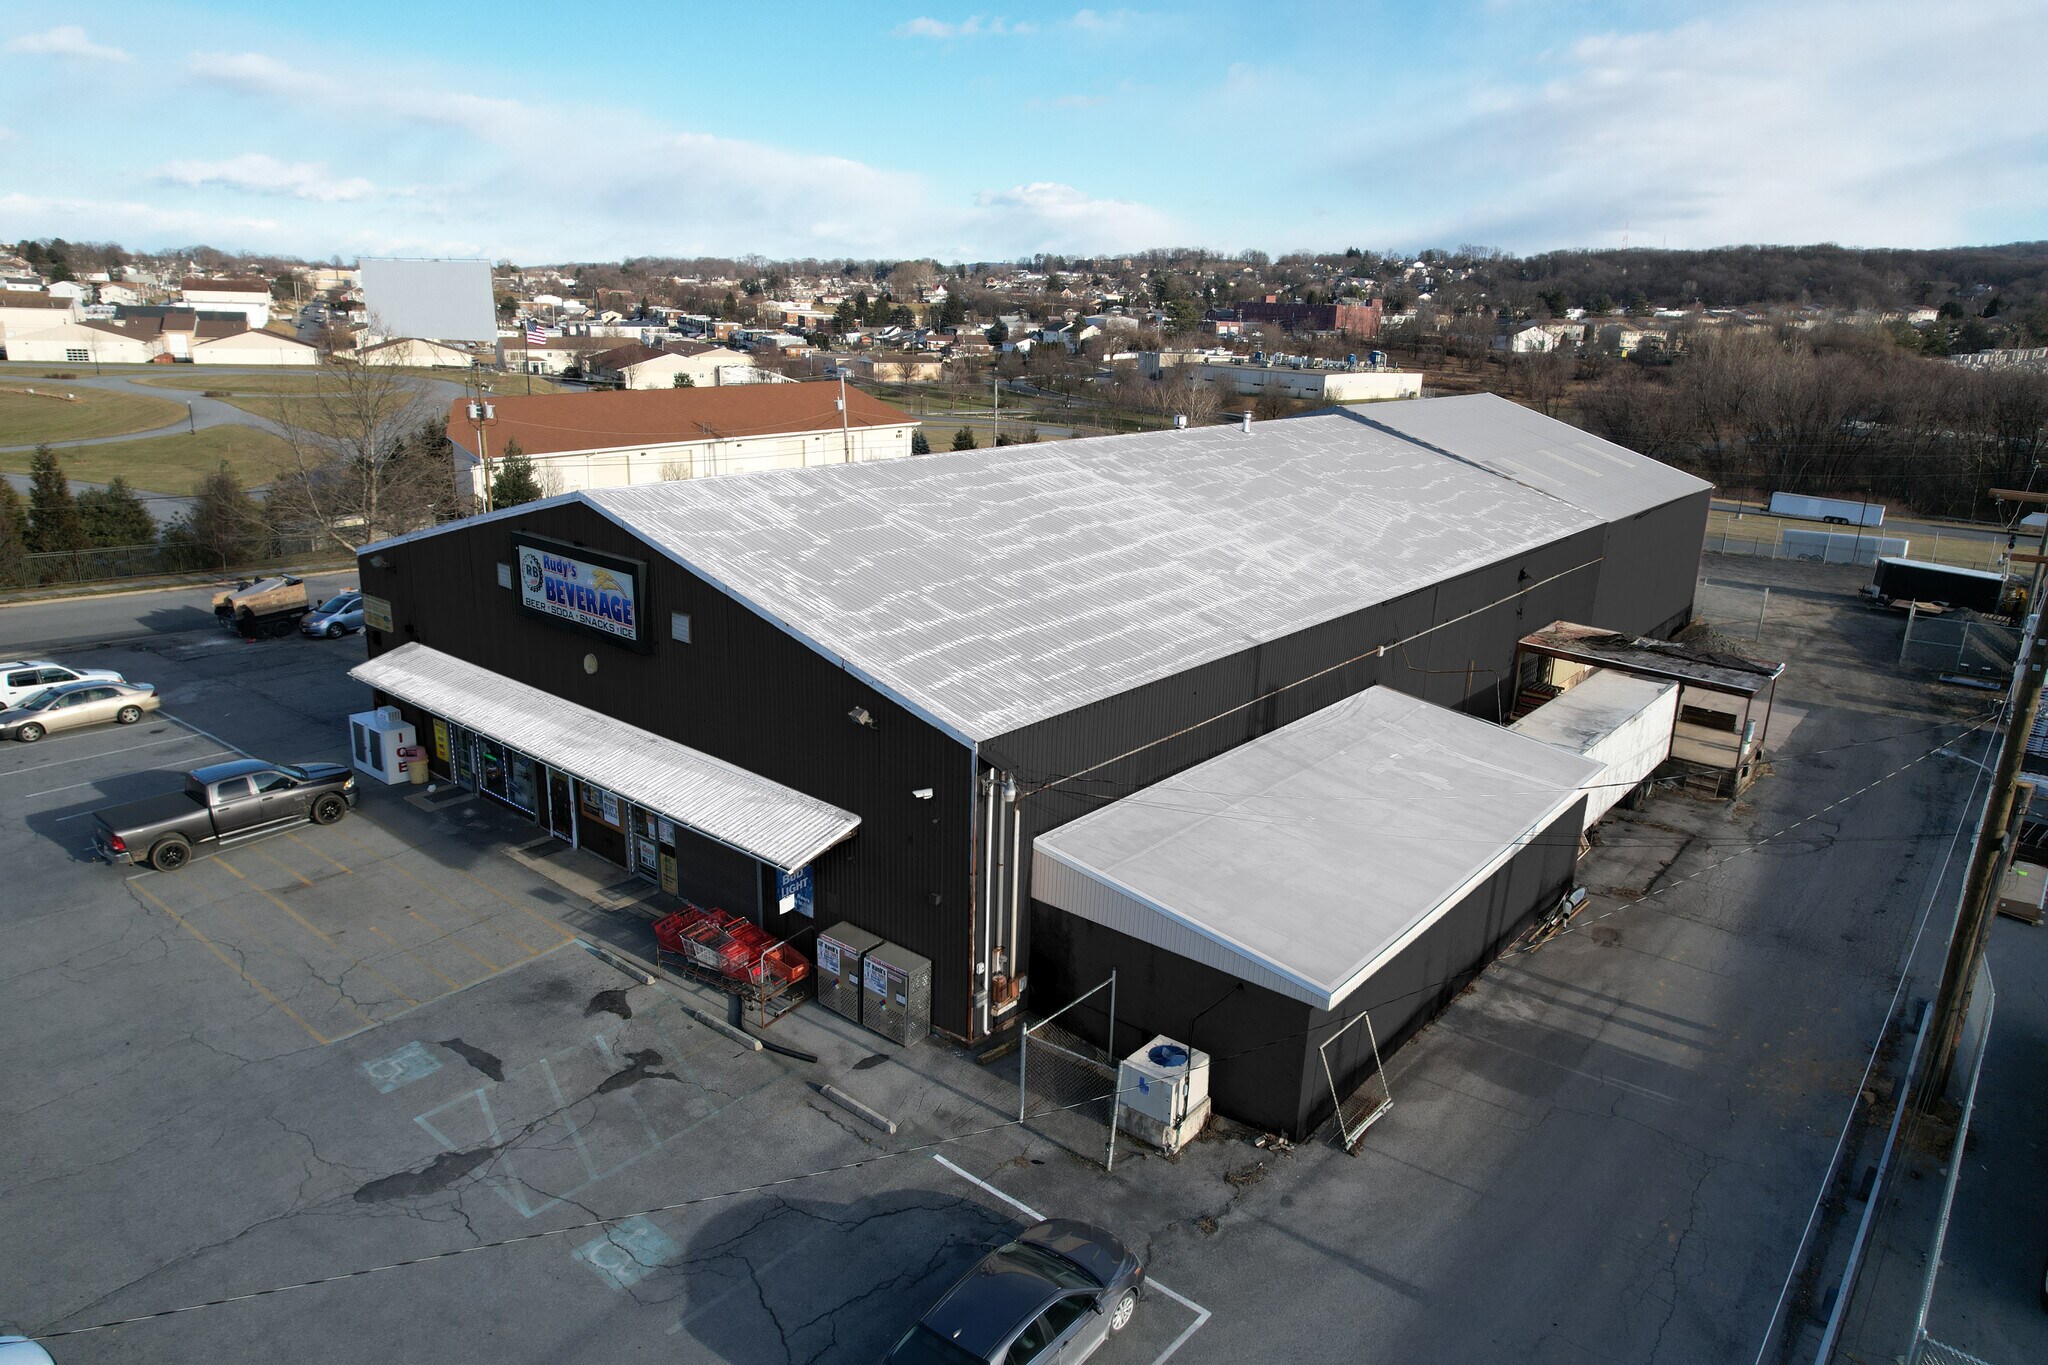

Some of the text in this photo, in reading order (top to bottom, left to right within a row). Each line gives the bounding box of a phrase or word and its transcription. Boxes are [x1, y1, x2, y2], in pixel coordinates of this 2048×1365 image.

[526, 564, 539, 578] RB
[543, 554, 577, 580] Rudy's
[544, 577, 634, 627] BEVERAGE
[525, 597, 634, 639] BEER SODA SNACKS ICE
[397, 732, 409, 773] ICE
[781, 877, 808, 898] LIGHT
[782, 869, 804, 886] BUD
